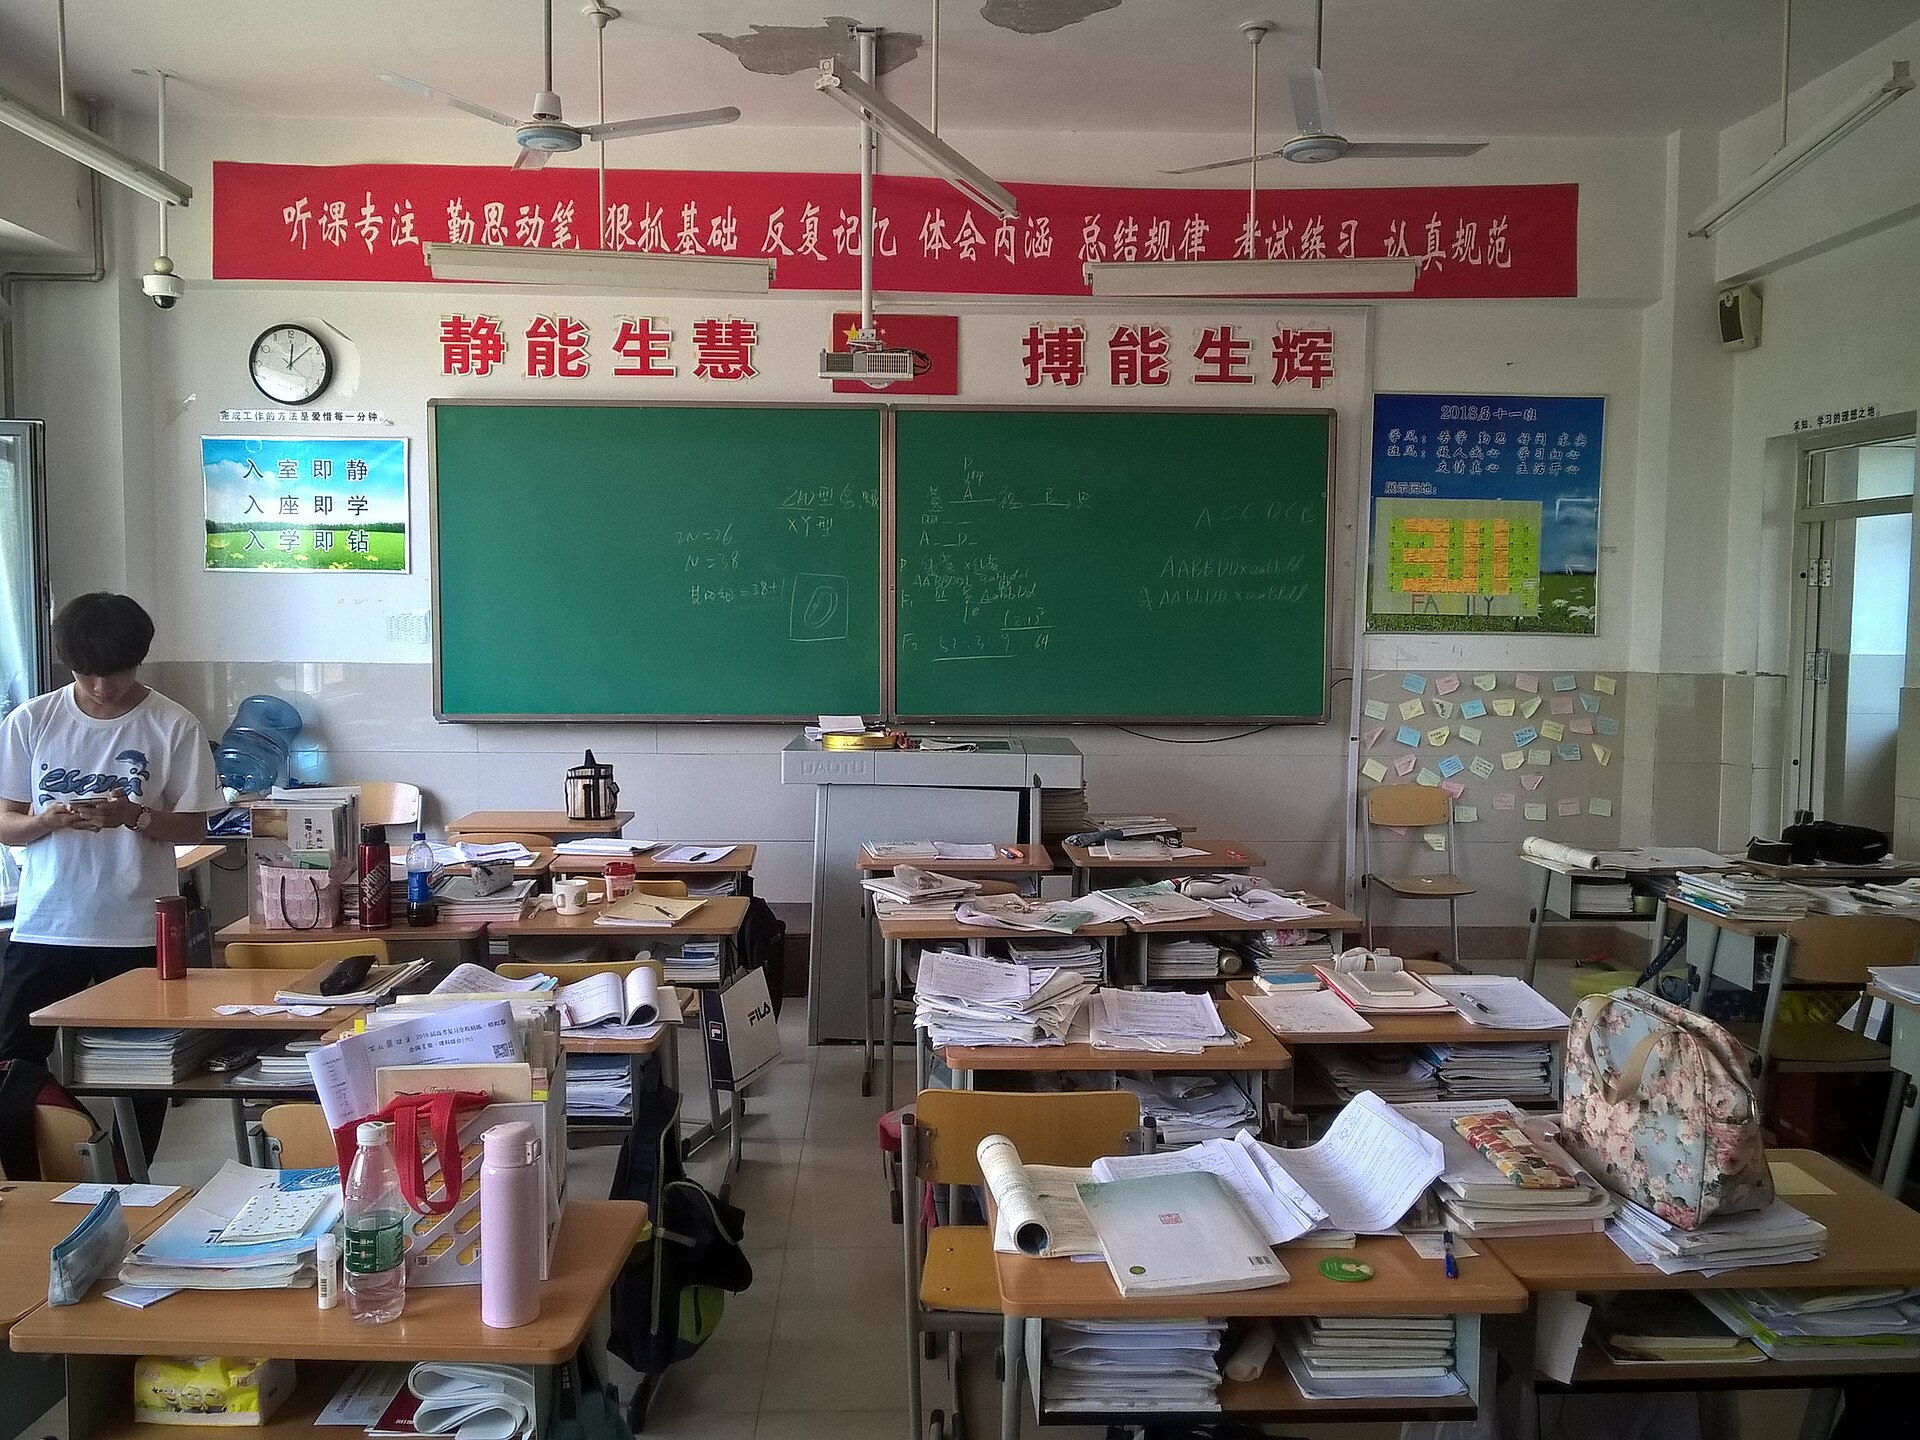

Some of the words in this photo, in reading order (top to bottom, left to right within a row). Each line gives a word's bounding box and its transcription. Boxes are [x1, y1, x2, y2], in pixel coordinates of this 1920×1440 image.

[282, 191, 420, 254] 听课专注
[446, 196, 580, 249] 勤思动笔
[604, 200, 739, 255] 狠抓基础
[761, 201, 897, 261] 反复记忆
[919, 207, 1054, 265] 体会内涵
[1078, 212, 1210, 262] 总结规律
[1233, 212, 1359, 260] 考试练习
[1384, 211, 1512, 272] 认真规范
[439, 314, 760, 381] 静能生慧
[1021, 325, 1336, 388] 搏能生辉
[242, 458, 369, 481] 入室即静
[243, 494, 369, 517] 入座即学
[244, 529, 370, 553] 入学即钻
[747, 1001, 772, 1027] FILA
